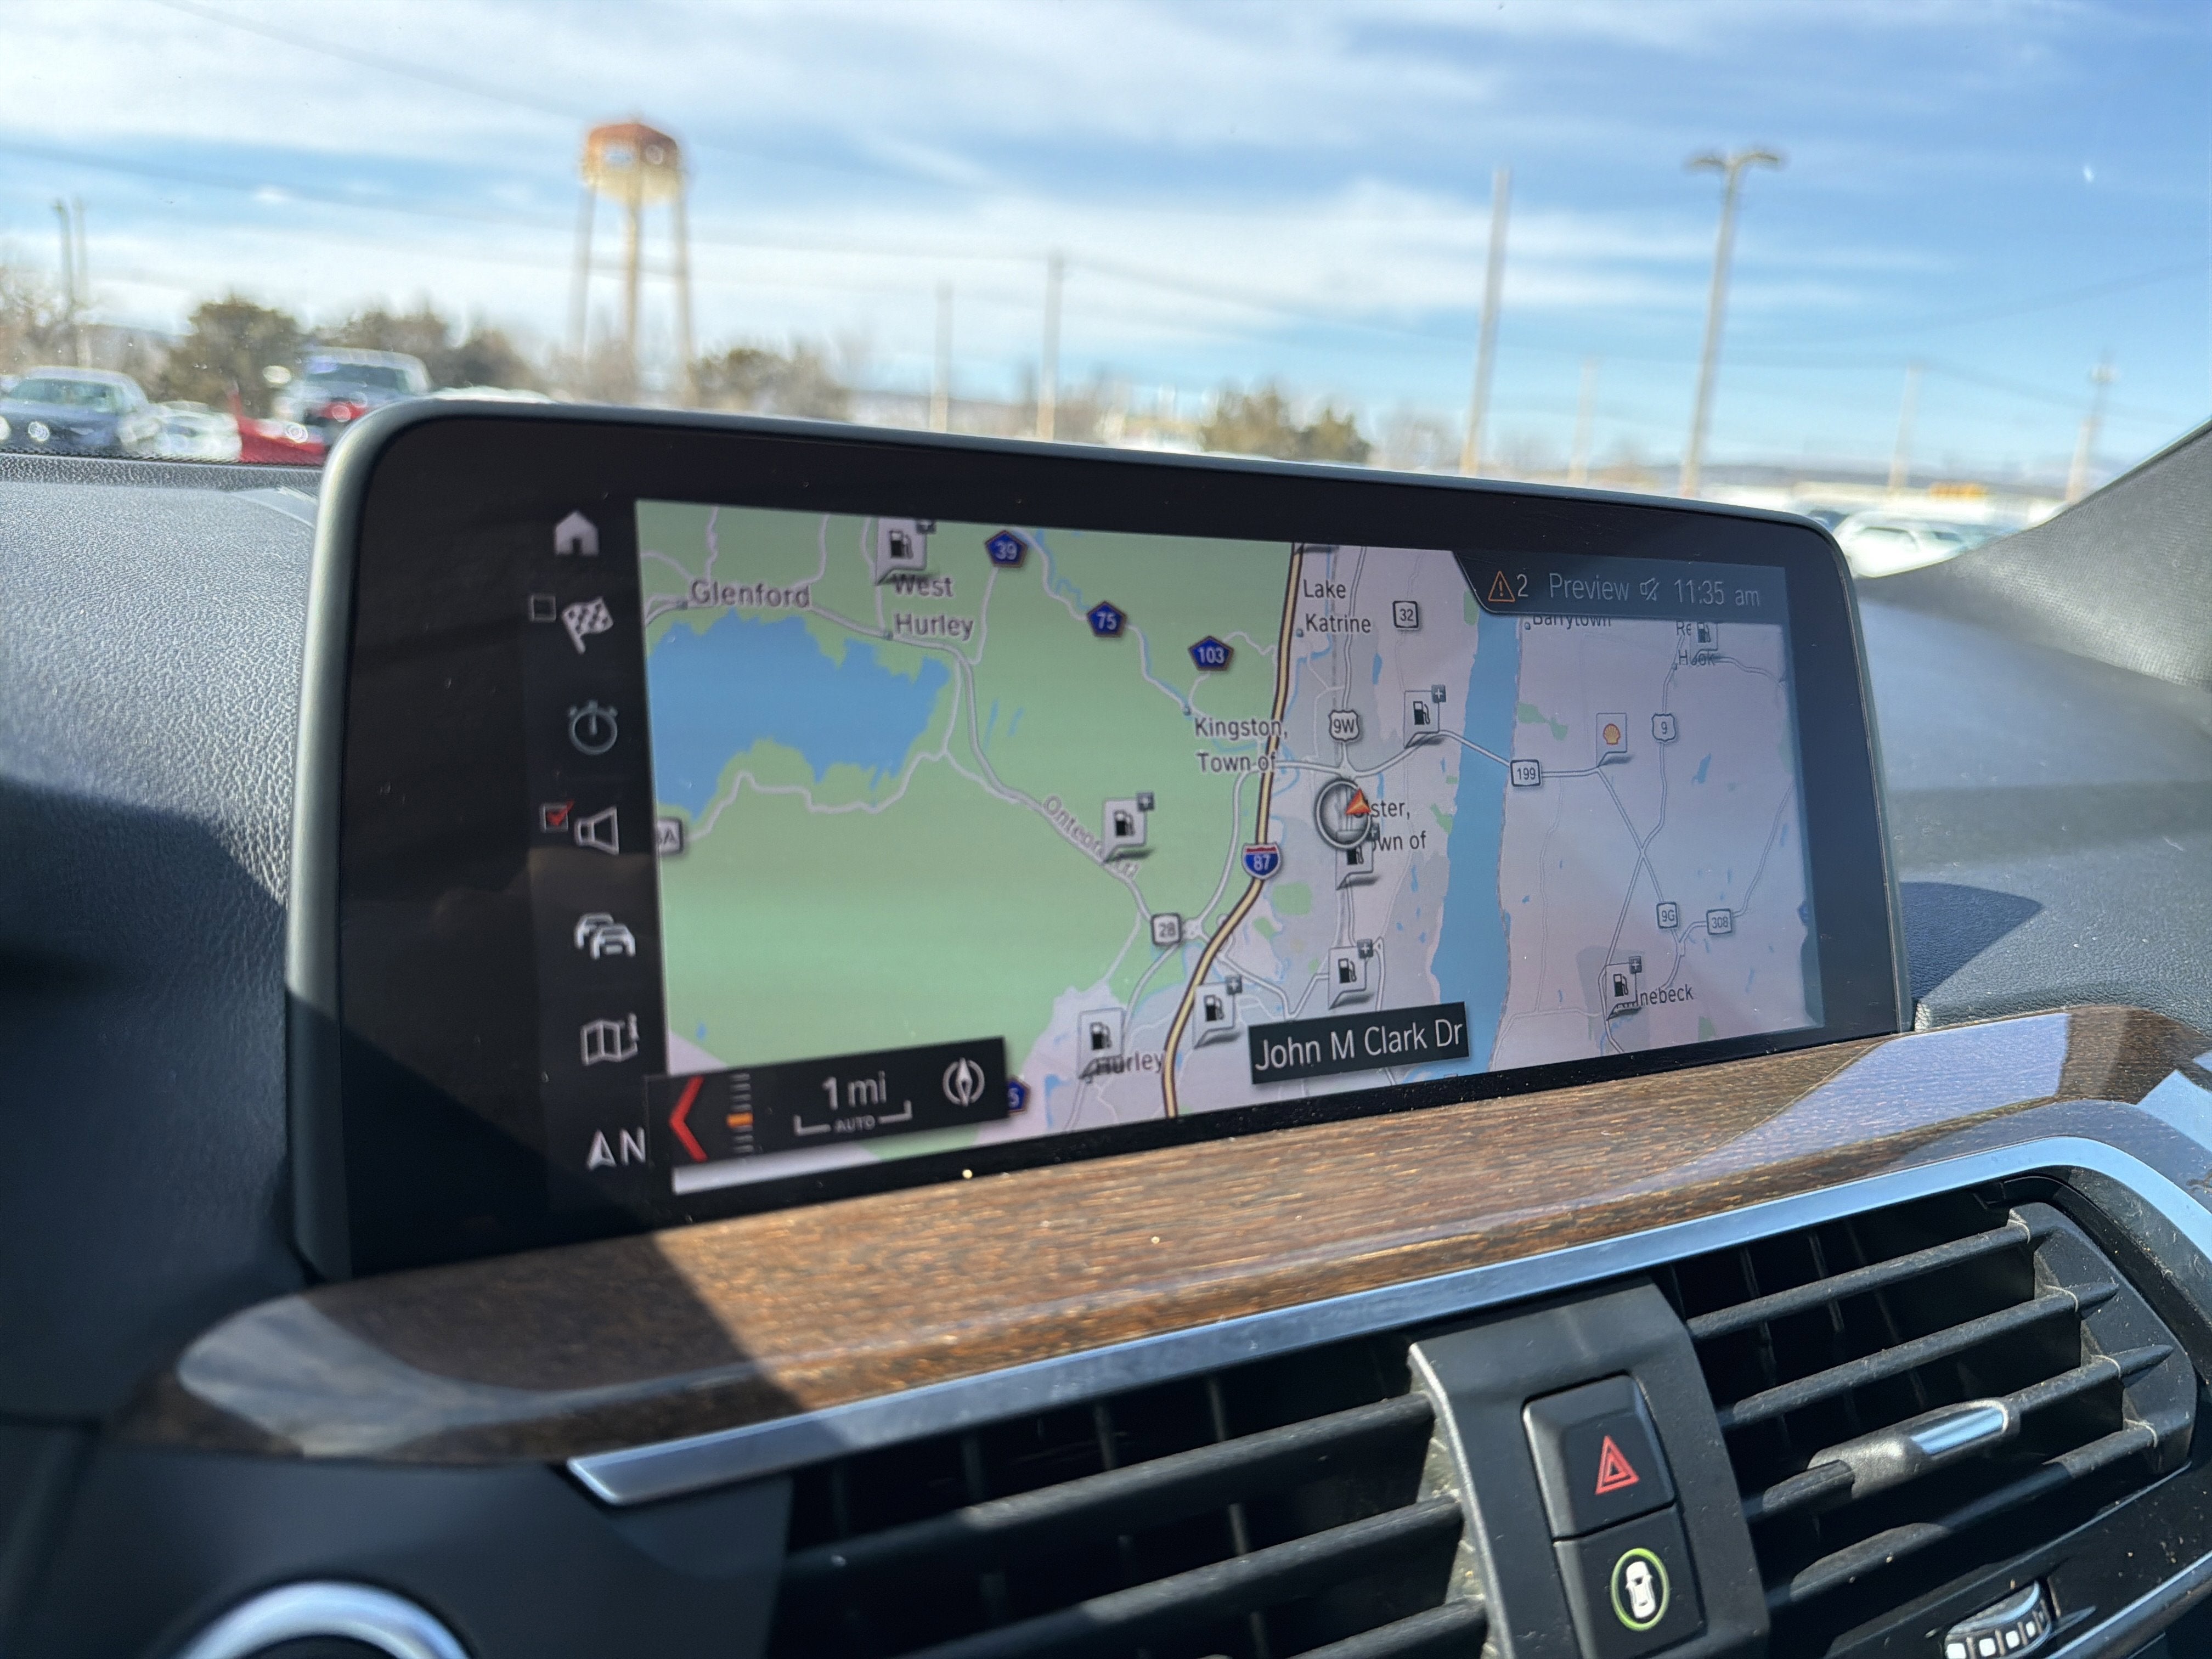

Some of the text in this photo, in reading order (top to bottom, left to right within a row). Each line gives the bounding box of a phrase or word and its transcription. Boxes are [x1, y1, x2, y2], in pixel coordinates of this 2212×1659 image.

[996, 543, 1017, 560] 39
[691, 579, 810, 607] Glenford
[895, 574, 953, 597] West
[1304, 578, 1346, 599] Lake
[1517, 572, 1759, 606] 2 Preview 11:35 am
[1097, 613, 1117, 630] 75
[1305, 613, 1371, 634] Katrine
[1400, 608, 1414, 622] 32
[894, 614, 973, 640] Hurley
[1199, 647, 1224, 663] 103
[1194, 719, 1288, 741] Kingston,
[1334, 720, 1354, 733] 9W
[1661, 722, 1667, 734] 9
[1198, 752, 1276, 772] Town of
[1517, 768, 1536, 781] 199
[1354, 799, 1411, 821] ster,
[1409, 830, 1426, 850] of
[1254, 857, 1270, 871] 87
[1661, 910, 1675, 923] 9G
[1712, 916, 1729, 929] 308
[1159, 922, 1176, 937] 28
[1255, 1019, 1464, 1071] John M Clark Dr
[823, 1071, 887, 1110] 1 mi
[834, 1116, 875, 1133] AUTO
[620, 1127, 645, 1164] N
